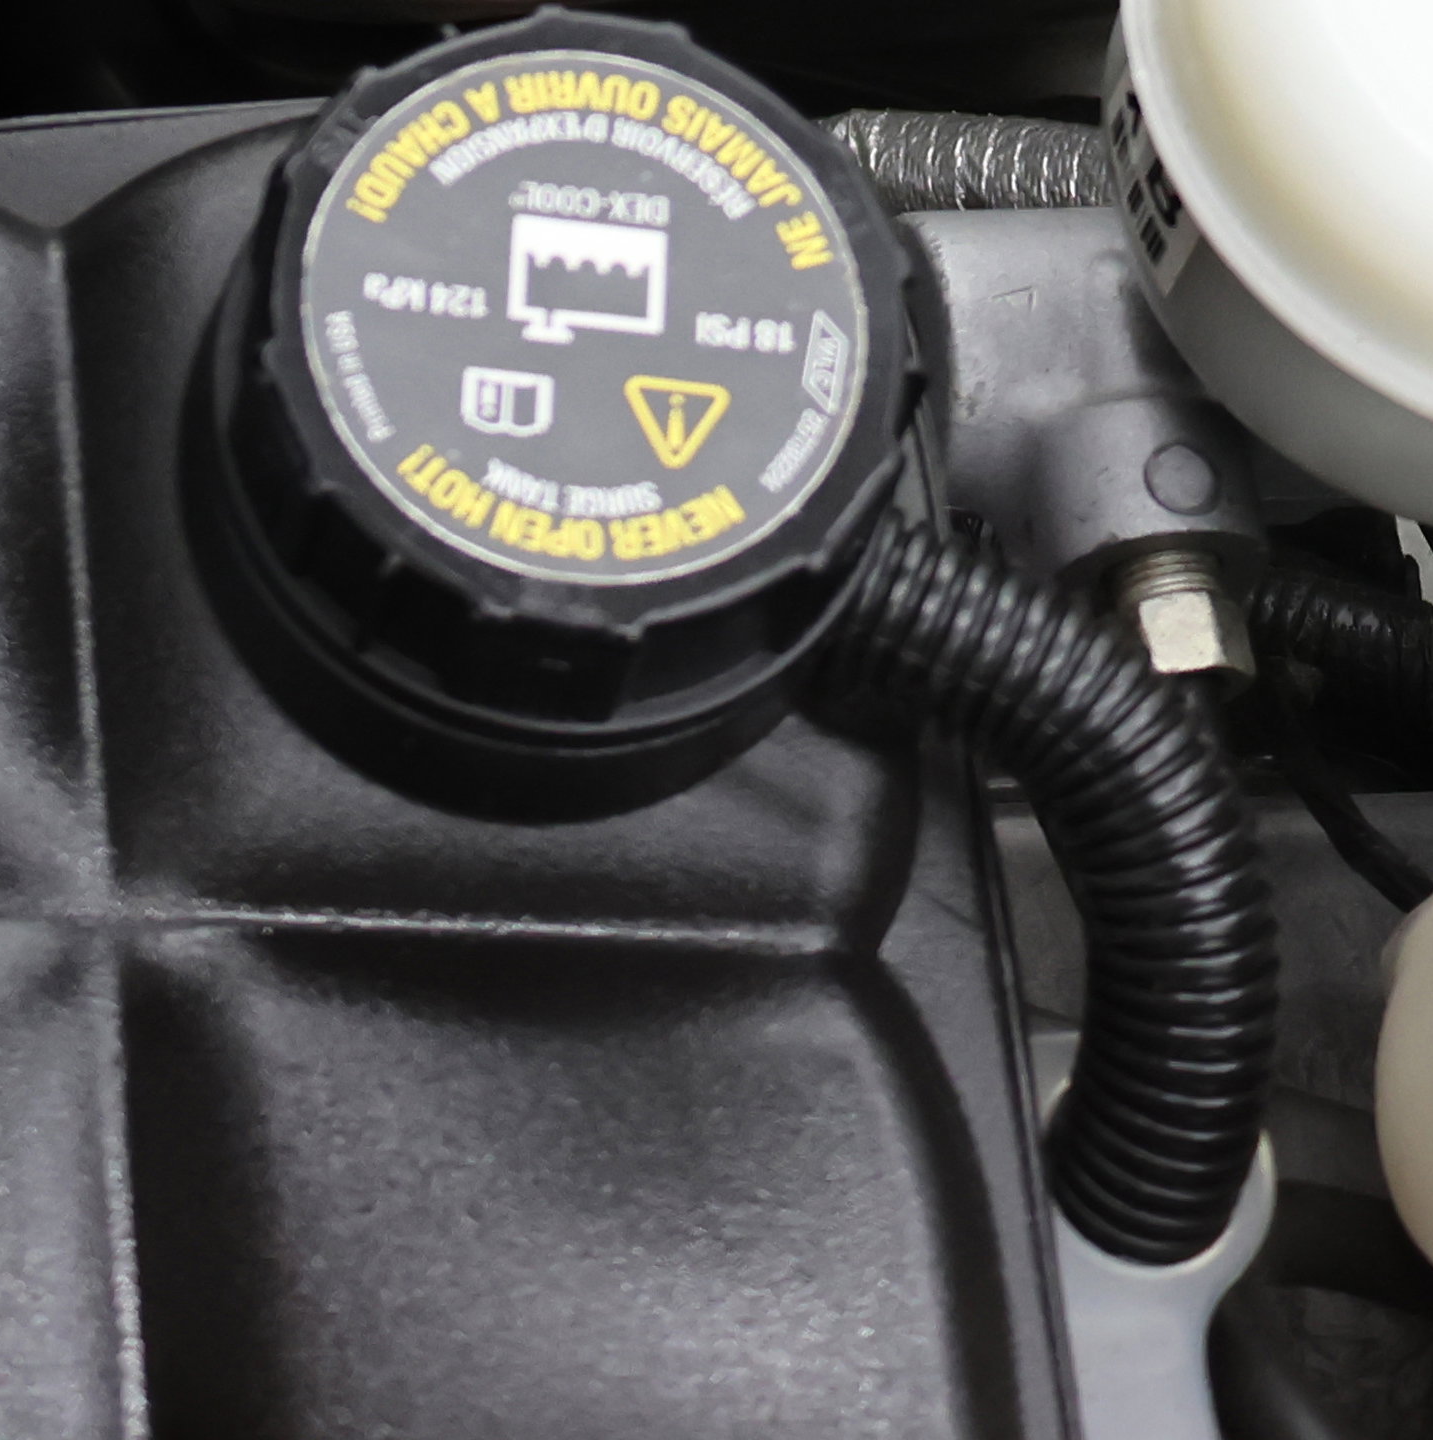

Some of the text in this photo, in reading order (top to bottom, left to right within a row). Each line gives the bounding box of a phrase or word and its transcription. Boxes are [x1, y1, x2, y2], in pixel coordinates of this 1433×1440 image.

[507, 70, 662, 115] OUVRIR
[345, 99, 471, 223] CHAUD!
[667, 95, 805, 209] JAMAIS
[775, 213, 834, 270] NE
[429, 282, 491, 319] 124
[694, 312, 797, 355] 18 PSI
[396, 443, 746, 560] NEVER OPEN HOT!
[479, 457, 665, 518] SURGE TANK
